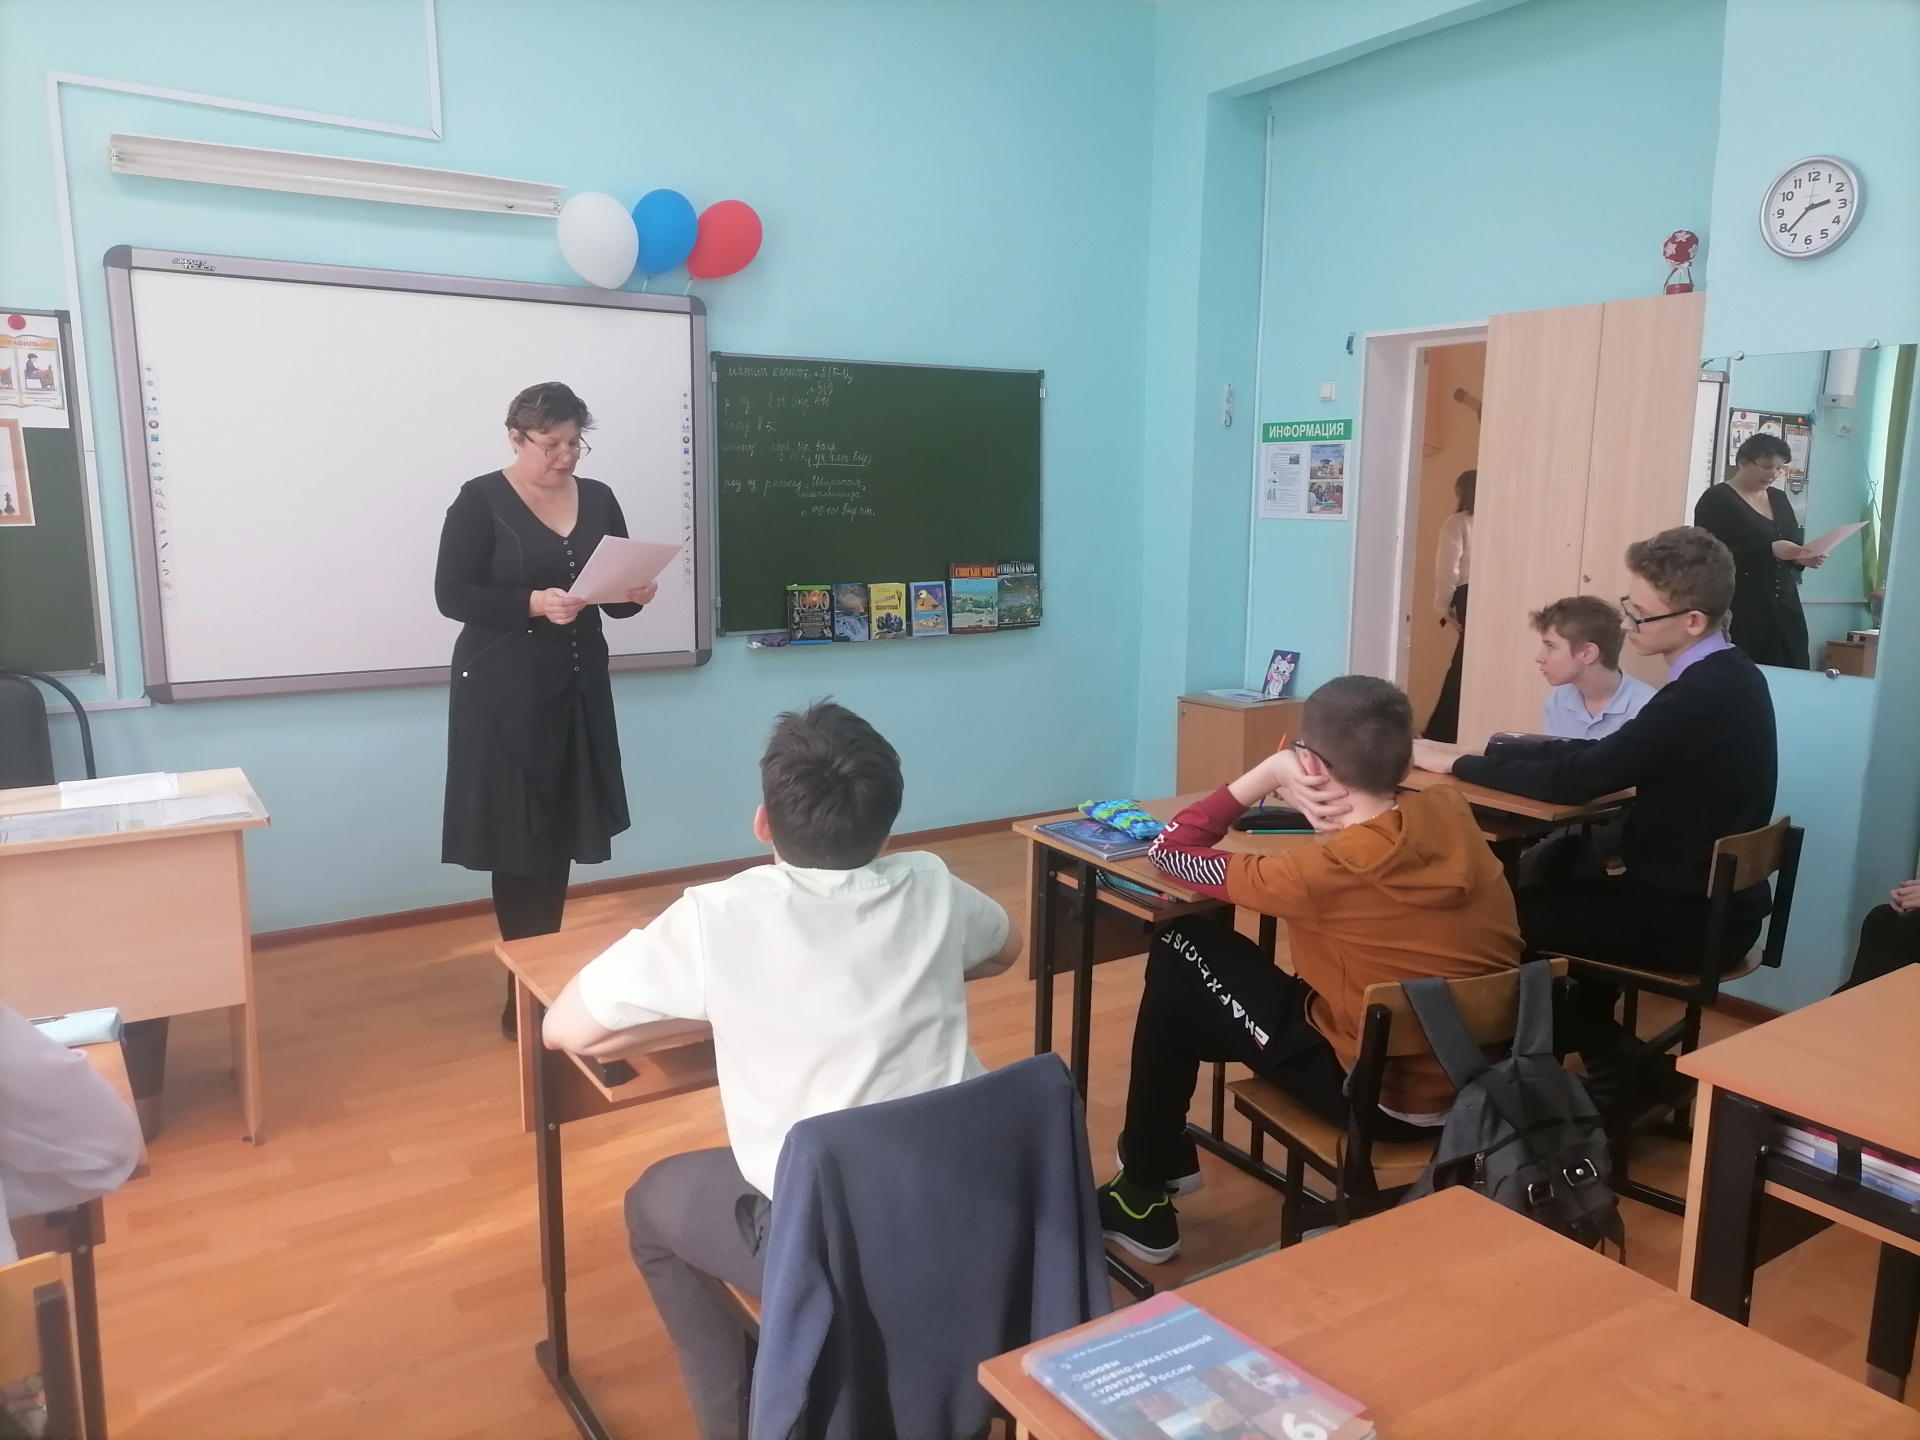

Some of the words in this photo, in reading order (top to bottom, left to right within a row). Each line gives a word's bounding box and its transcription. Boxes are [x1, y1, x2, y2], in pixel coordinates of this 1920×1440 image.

[1808, 171, 1821, 182] 12
[1828, 174, 1832, 184] 1
[1794, 178, 1802, 189] 11
[1835, 182, 1845, 193] 2
[1782, 191, 1794, 202] 10
[1838, 198, 1848, 209] 3
[1777, 208, 1785, 218] 9
[1832, 215, 1841, 225] 4
[1779, 223, 1788, 233] 8
[1789, 233, 1798, 243] 7
[1820, 229, 1829, 239] 5
[1804, 235, 1813, 245] 6
[1269, 423, 1344, 438] ИНФОРМАЦИЯ
[793, 590, 830, 610] 1000
[1282, 1412, 1328, 1440] 6
